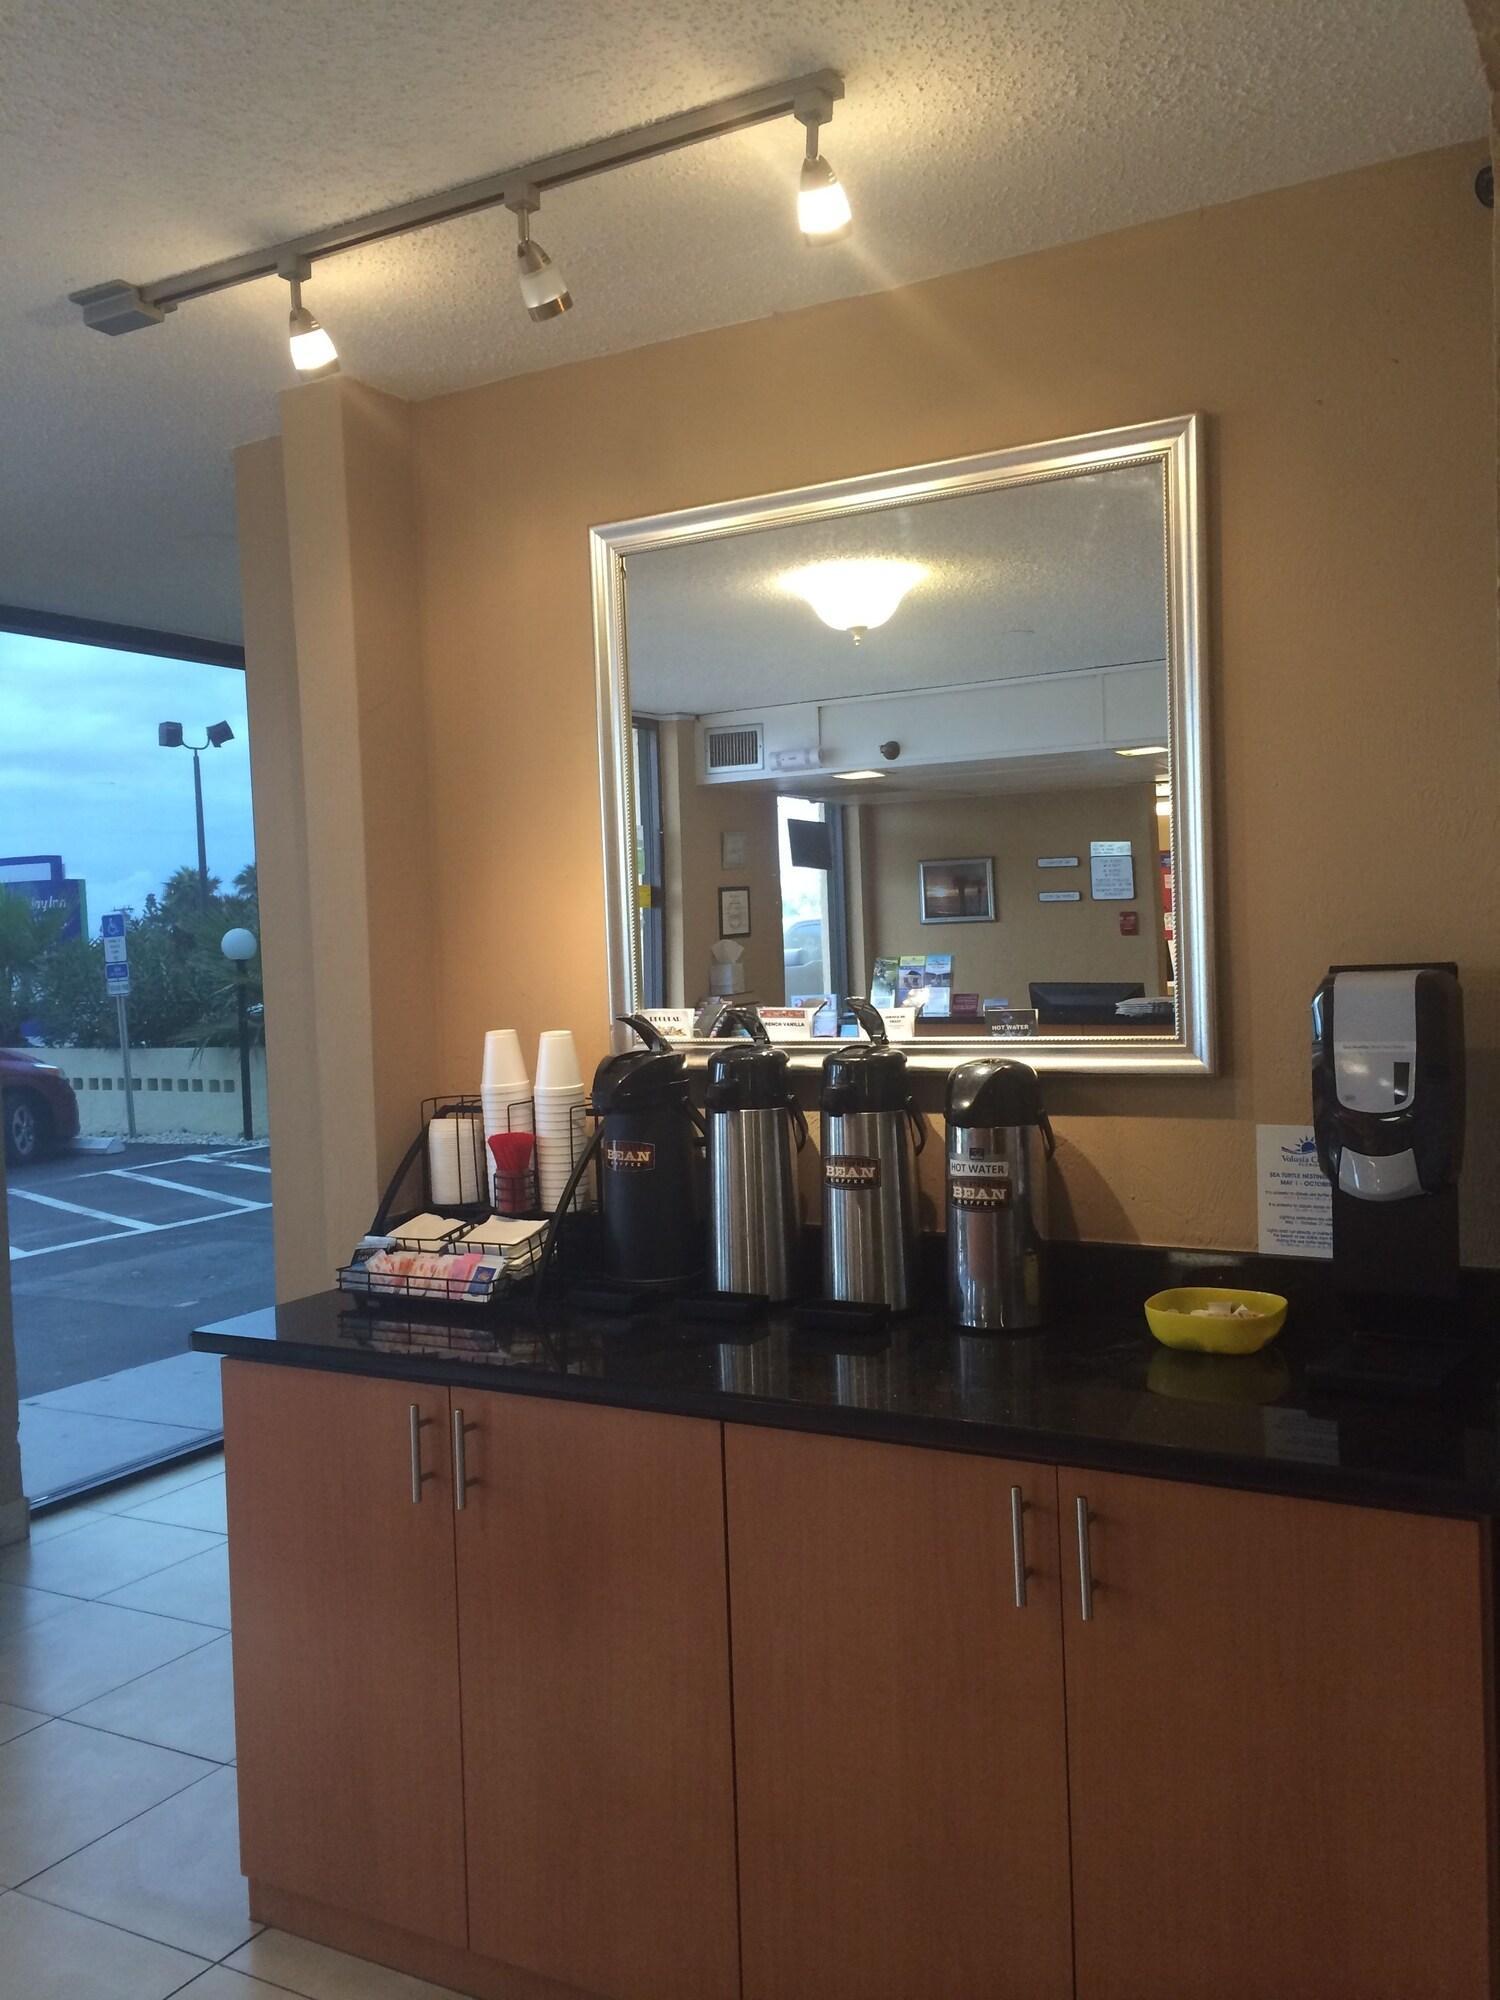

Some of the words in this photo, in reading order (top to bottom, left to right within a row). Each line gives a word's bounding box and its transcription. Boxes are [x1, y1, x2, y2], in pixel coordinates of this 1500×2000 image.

[607, 1149, 651, 1162] BEAN
[826, 1165, 876, 1178] BEAN
[951, 1161, 966, 1172] HOT
[968, 1164, 1004, 1174] WATER
[952, 1185, 1007, 1200] BEAN
